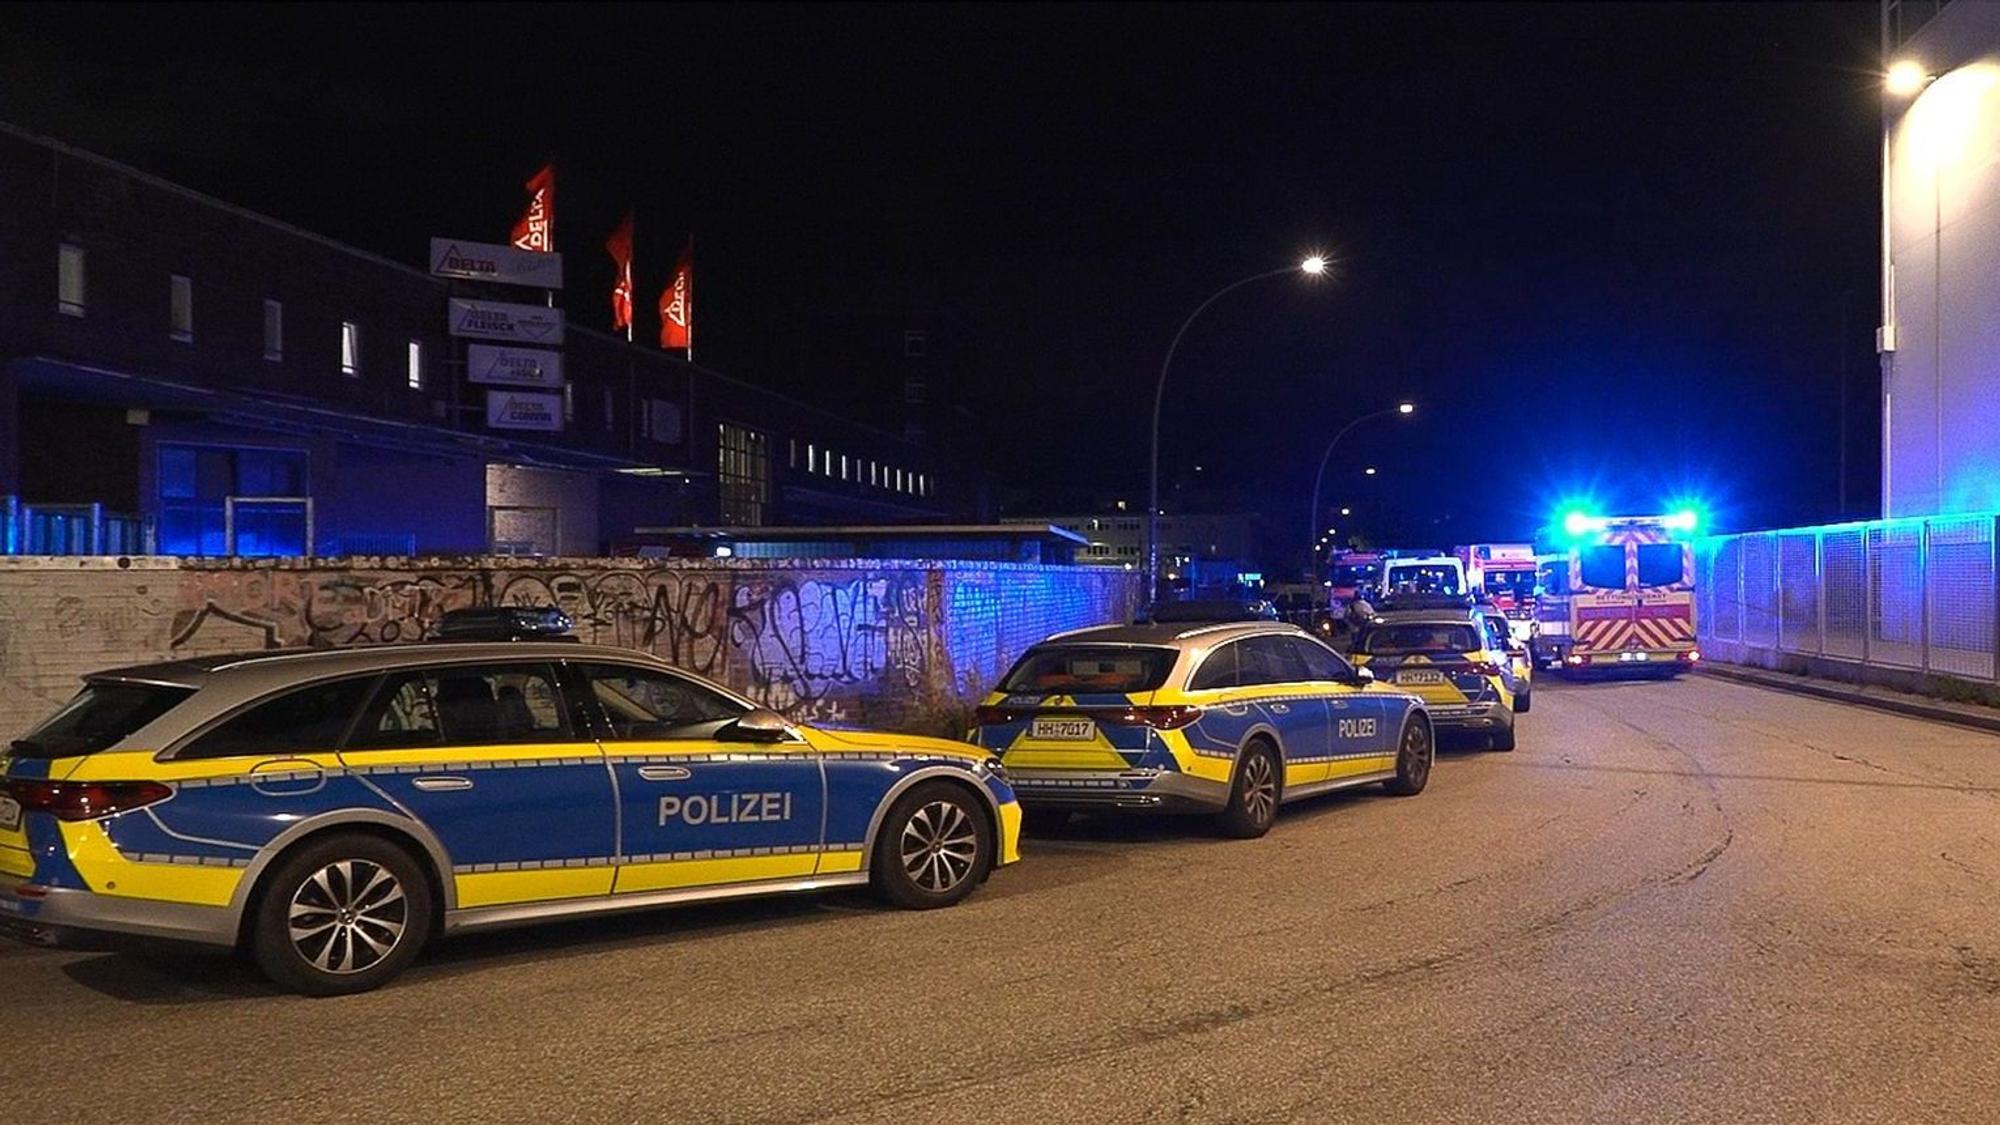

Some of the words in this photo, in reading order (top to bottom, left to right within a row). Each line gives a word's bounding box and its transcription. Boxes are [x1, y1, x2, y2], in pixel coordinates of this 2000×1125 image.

[448, 256, 496, 273] DELTA
[500, 357, 537, 368] DELTA
[1037, 723, 1054, 735] HH
[1060, 723, 1090, 736] 7017
[1338, 718, 1376, 740] POLIZEI
[657, 791, 792, 827] POLIZEI
